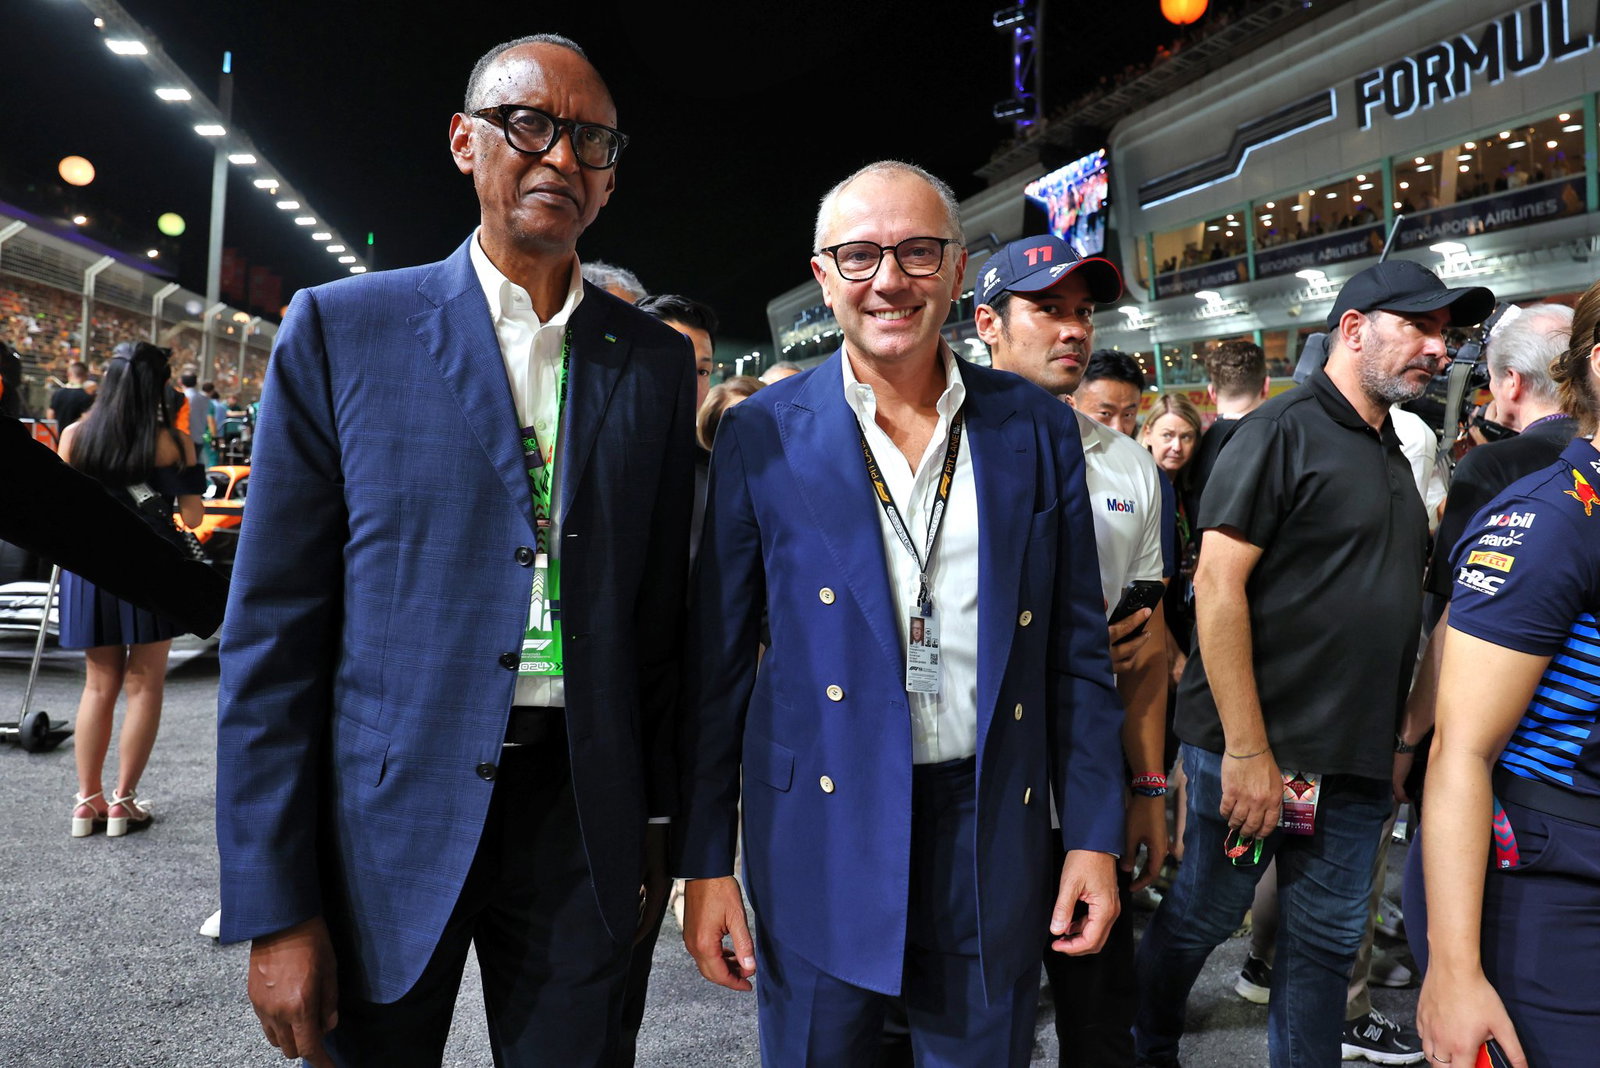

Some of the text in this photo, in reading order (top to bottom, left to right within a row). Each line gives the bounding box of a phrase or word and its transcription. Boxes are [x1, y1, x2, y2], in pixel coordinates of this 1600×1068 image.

[1355, 0, 1600, 131] FORMUL
[1485, 199, 1557, 227] AIRLINES
[1023, 245, 1053, 267] 11
[945, 458, 955, 473] PIT
[950, 434, 960, 458] LANE
[1484, 511, 1536, 529] Mobil
[1459, 566, 1506, 593] HRC
[519, 662, 547, 671] 024
[1132, 775, 1166, 785] NDAY
